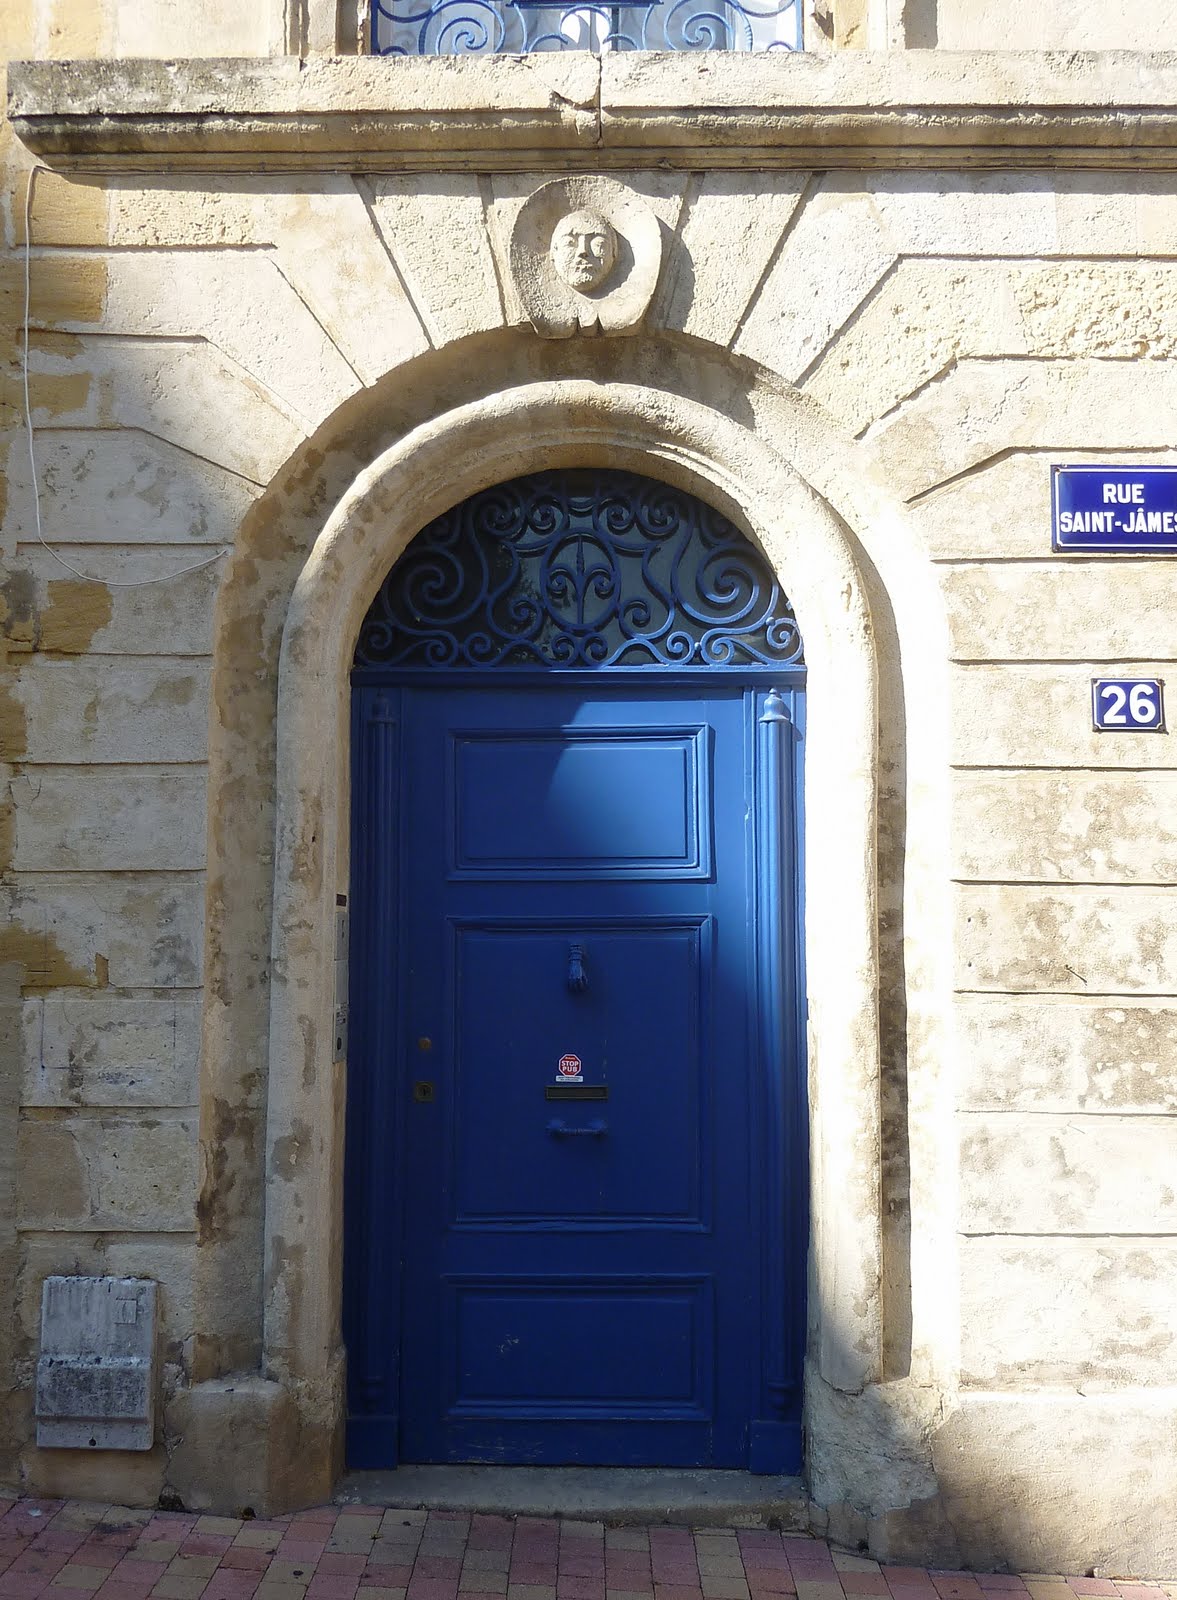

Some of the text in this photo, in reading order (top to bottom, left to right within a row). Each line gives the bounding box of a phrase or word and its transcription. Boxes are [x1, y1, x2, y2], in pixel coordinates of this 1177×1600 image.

[1103, 483, 1145, 504] RUE
[1060, 507, 1177, 533] SAINT-JÂME
[1101, 683, 1156, 724] 26
